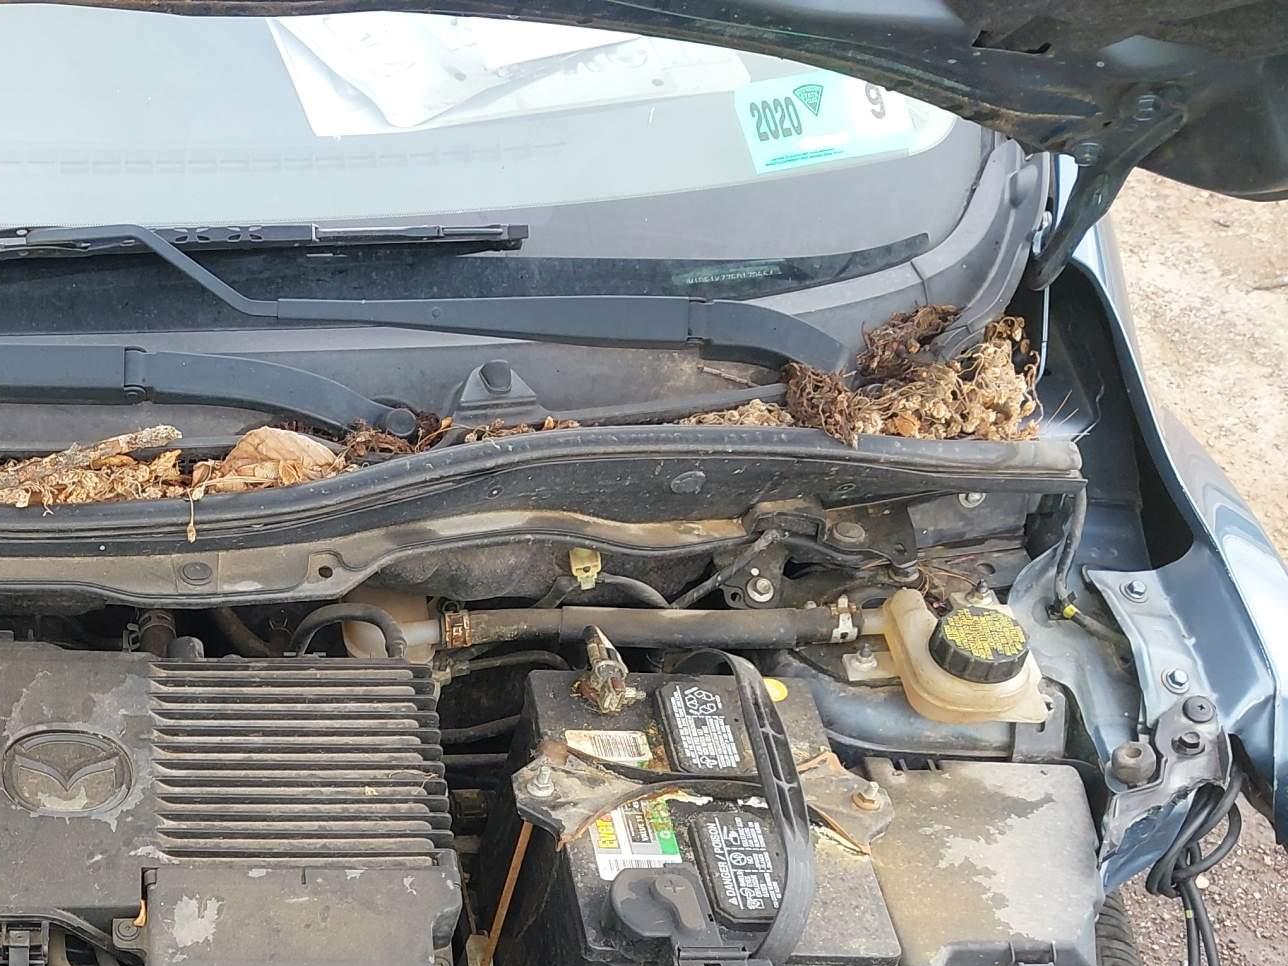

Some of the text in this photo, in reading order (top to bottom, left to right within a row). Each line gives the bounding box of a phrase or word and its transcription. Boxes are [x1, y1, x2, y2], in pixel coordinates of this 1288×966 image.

[750, 96, 803, 141] 2020
[706, 822, 726, 854] POISON
[718, 861, 737, 898] DANGER
